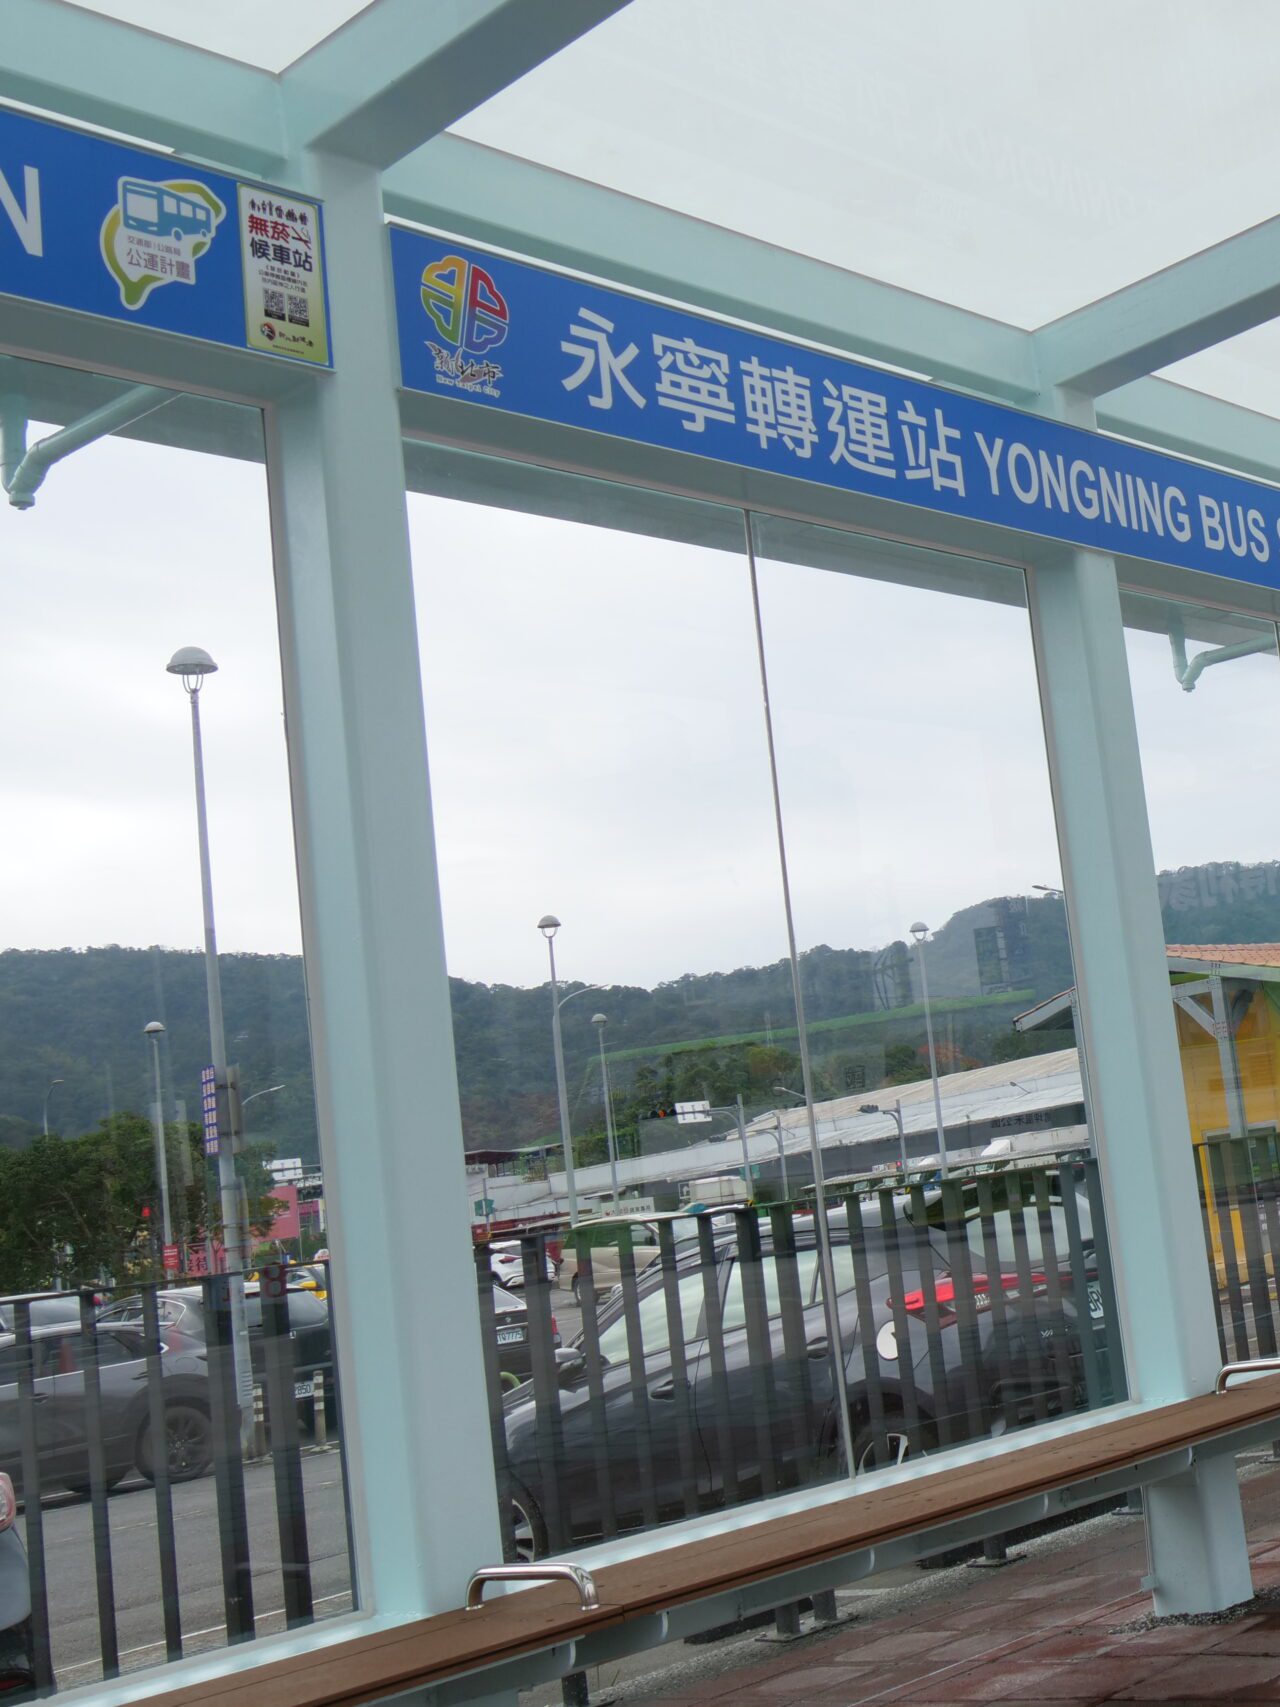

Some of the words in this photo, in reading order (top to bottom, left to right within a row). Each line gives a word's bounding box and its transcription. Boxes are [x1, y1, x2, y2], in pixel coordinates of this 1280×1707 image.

[250, 237, 313, 272] 候車站
[560, 307, 967, 497] 永寧轉運站
[974, 431, 1192, 543] YONGNING
[1198, 494, 1270, 562] BUS
